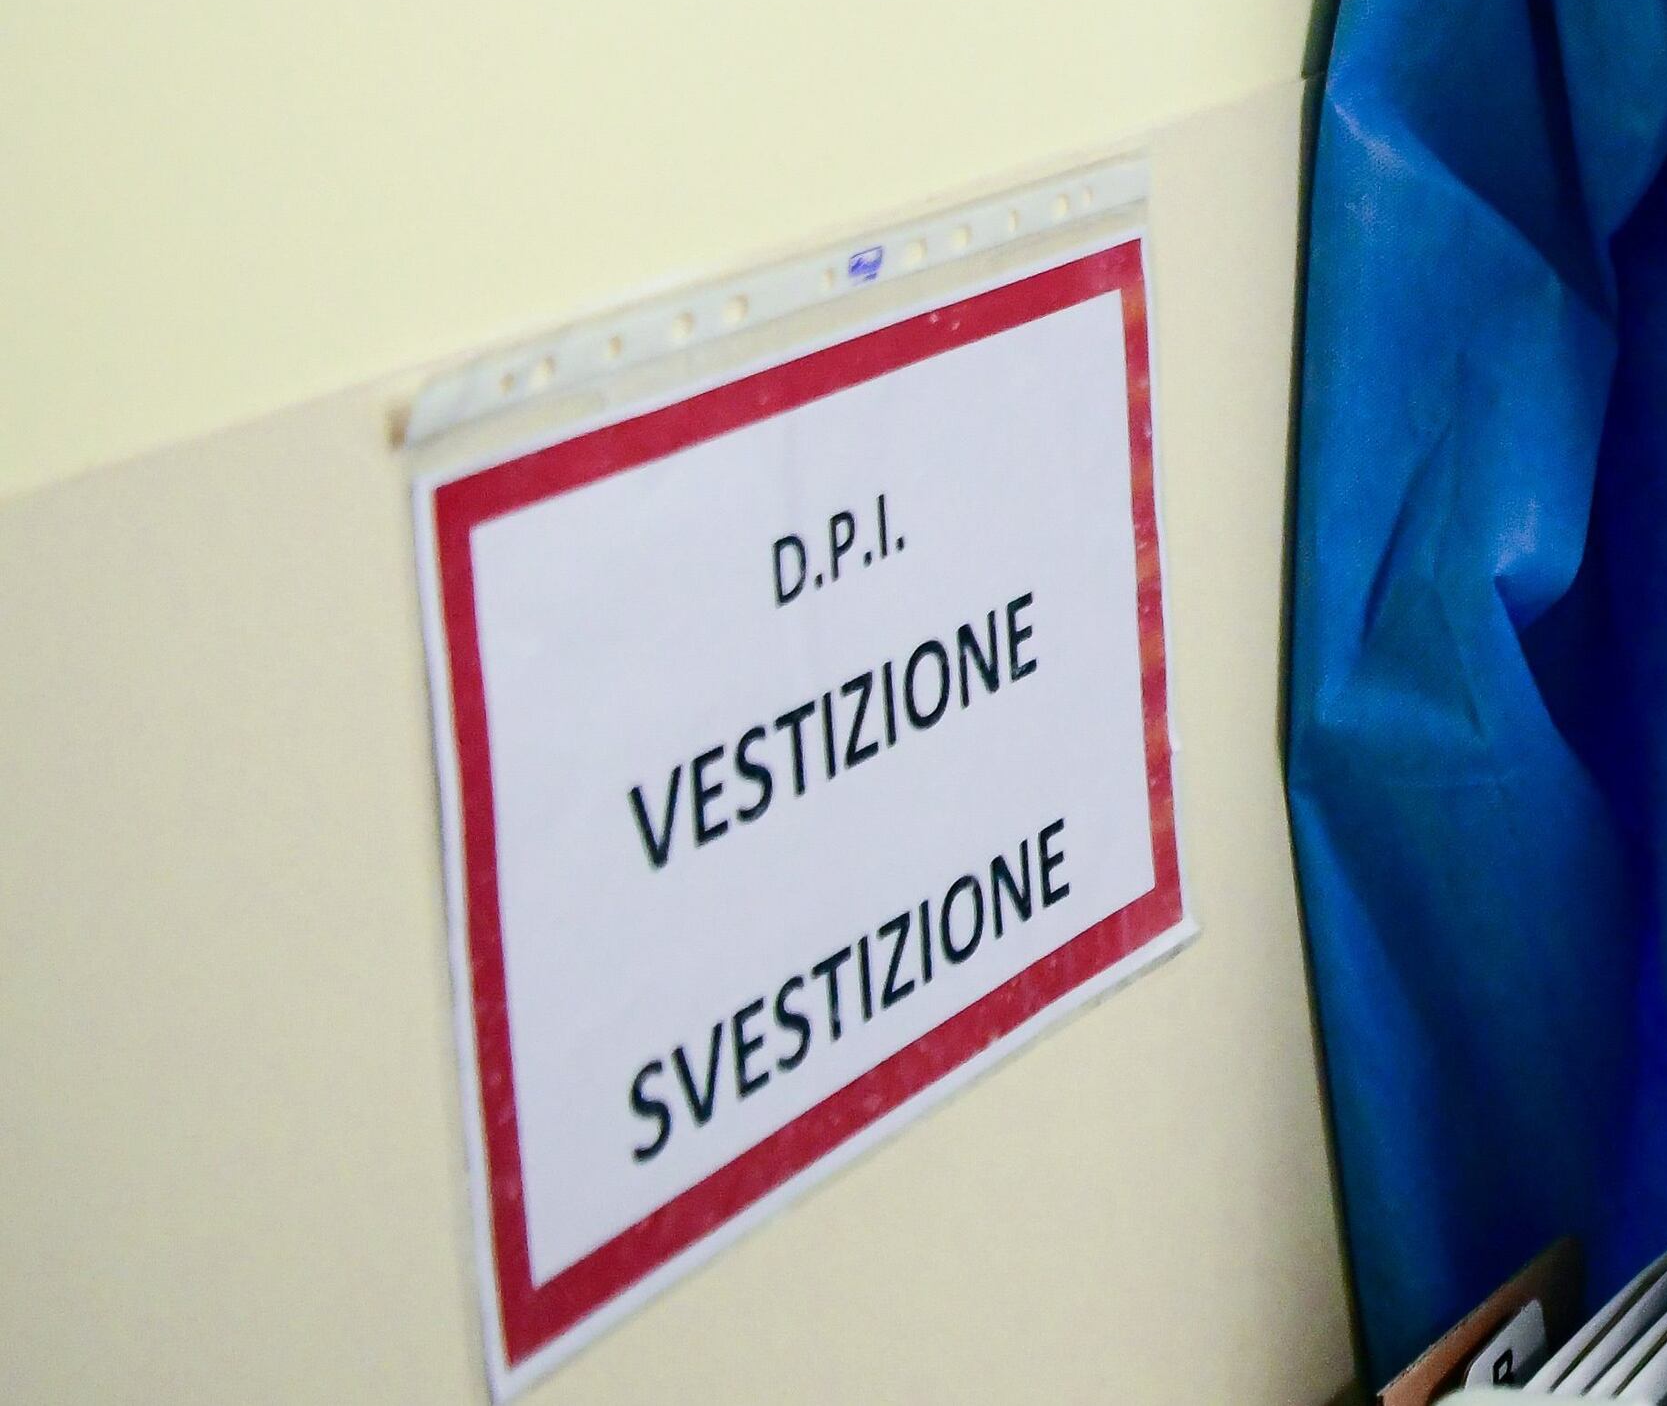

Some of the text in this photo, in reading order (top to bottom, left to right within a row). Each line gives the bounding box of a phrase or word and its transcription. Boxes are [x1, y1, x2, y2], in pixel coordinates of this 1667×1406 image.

[771, 493, 906, 605] D.P.I.
[628, 590, 1039, 870] VESTIZIONE
[629, 816, 1071, 1164] SVESTIZIONE
